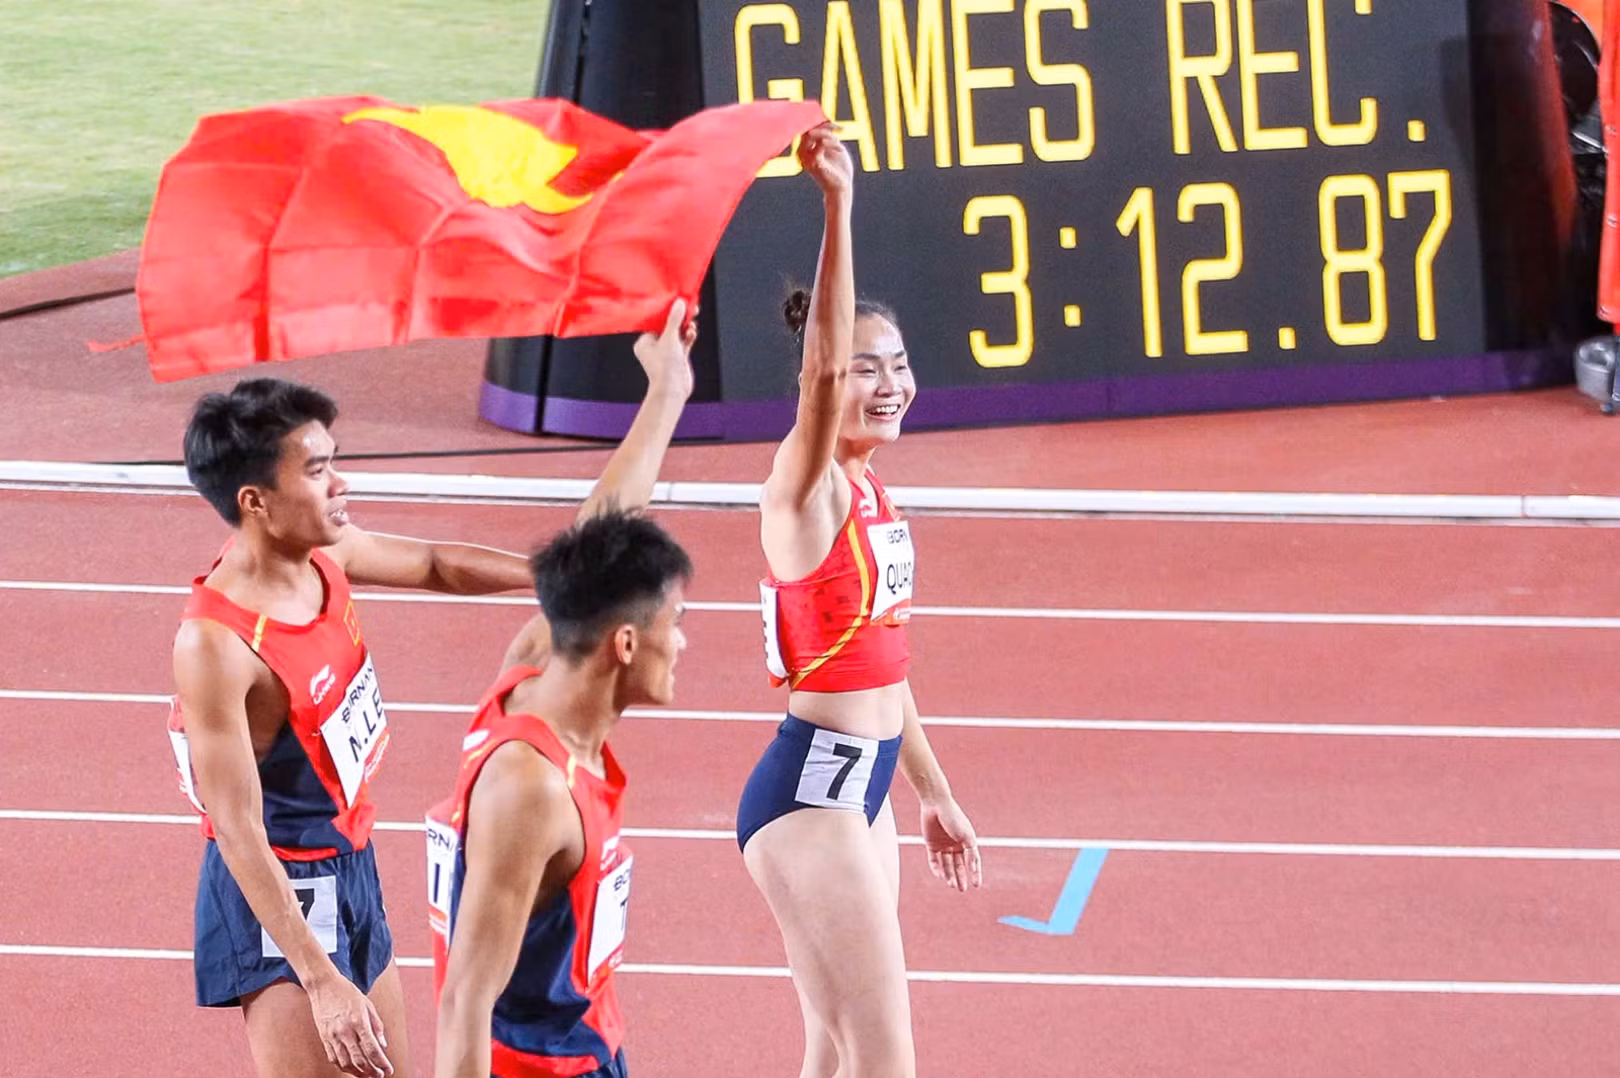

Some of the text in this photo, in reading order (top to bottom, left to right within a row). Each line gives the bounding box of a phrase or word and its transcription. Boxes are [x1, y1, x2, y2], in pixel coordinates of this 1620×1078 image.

[734, 0, 1426, 178] GAMES REC.
[962, 169, 1453, 369] 3:12.87
[826, 742, 863, 801] 7
